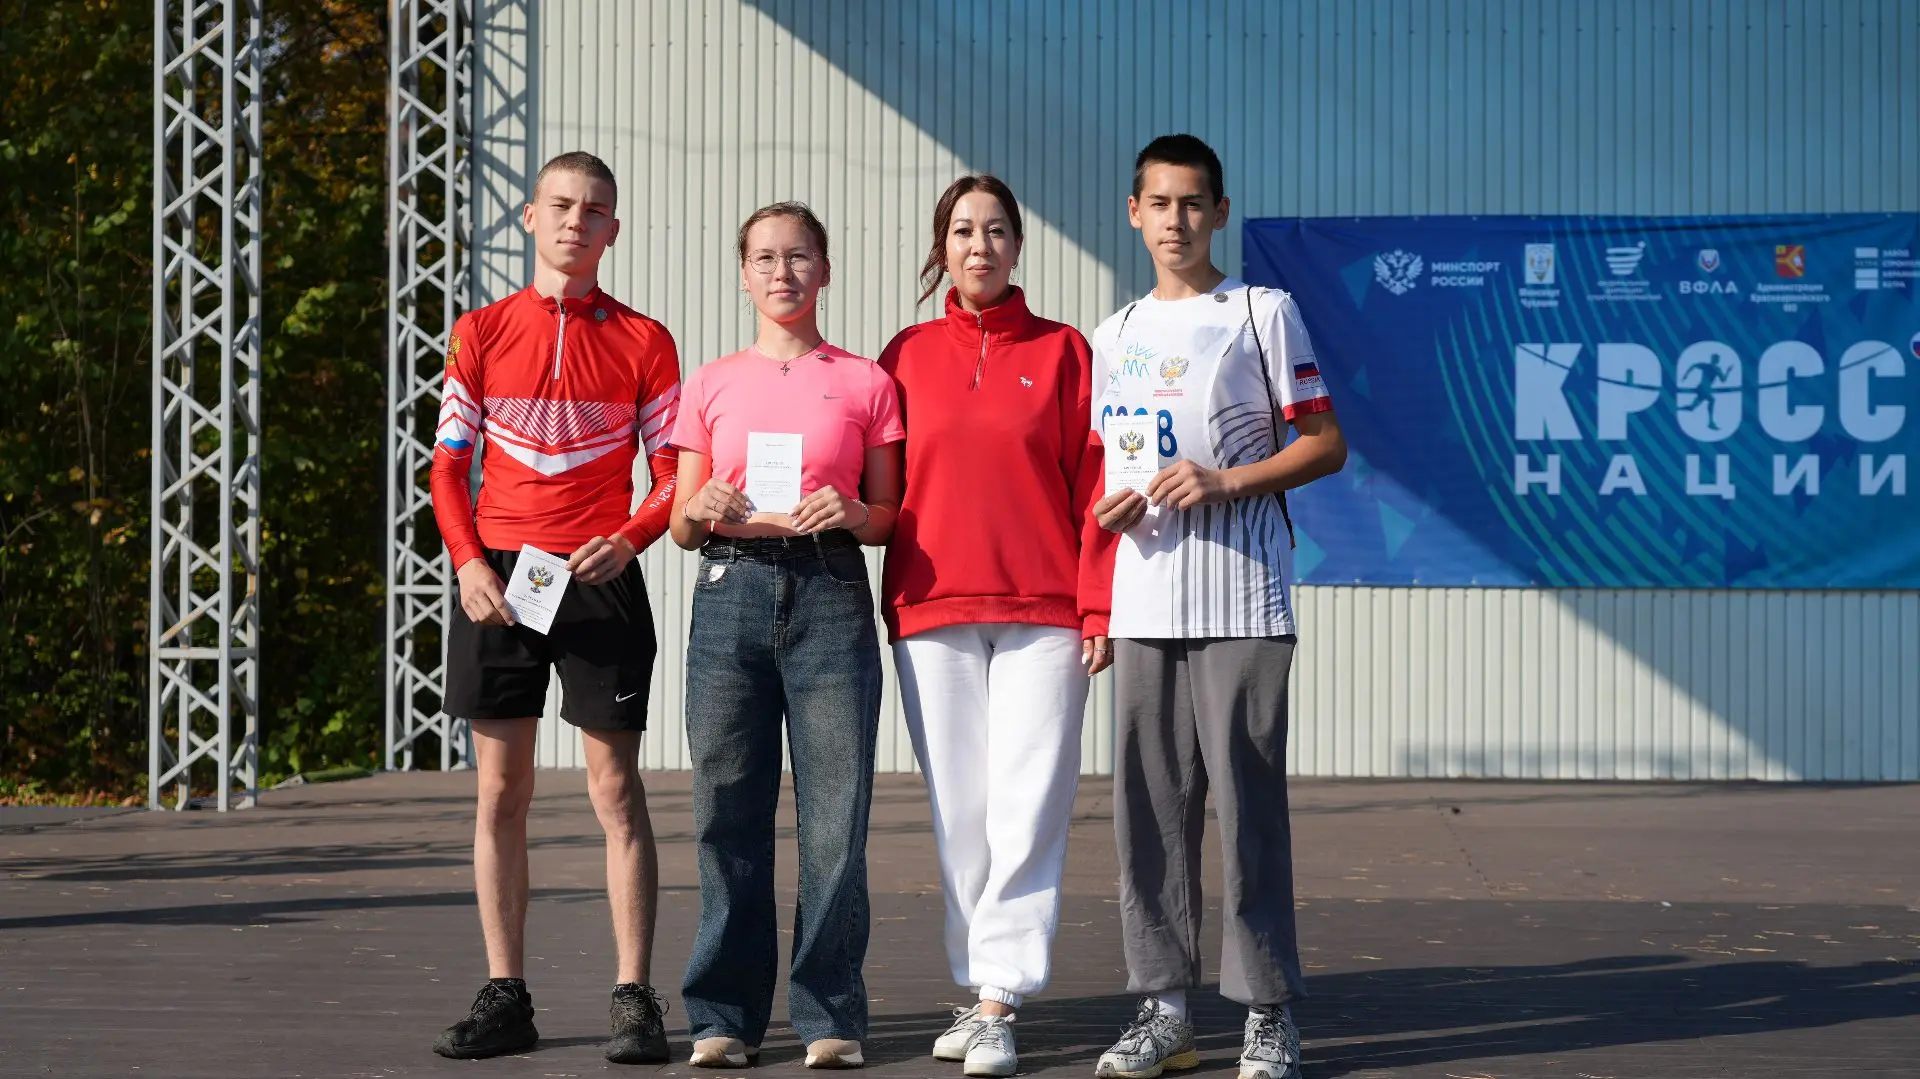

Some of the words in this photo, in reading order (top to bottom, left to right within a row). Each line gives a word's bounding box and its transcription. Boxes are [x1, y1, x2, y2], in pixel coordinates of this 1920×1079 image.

[1431, 261, 1500, 273] МИНСПОРТ
[1431, 276, 1484, 287] РОССИИ
[1679, 280, 1739, 294] ВФЛА
[1299, 376, 1321, 386] RUSSIA
[1515, 340, 1906, 442] КРОСС
[1515, 454, 1906, 499] НАЦИИ
